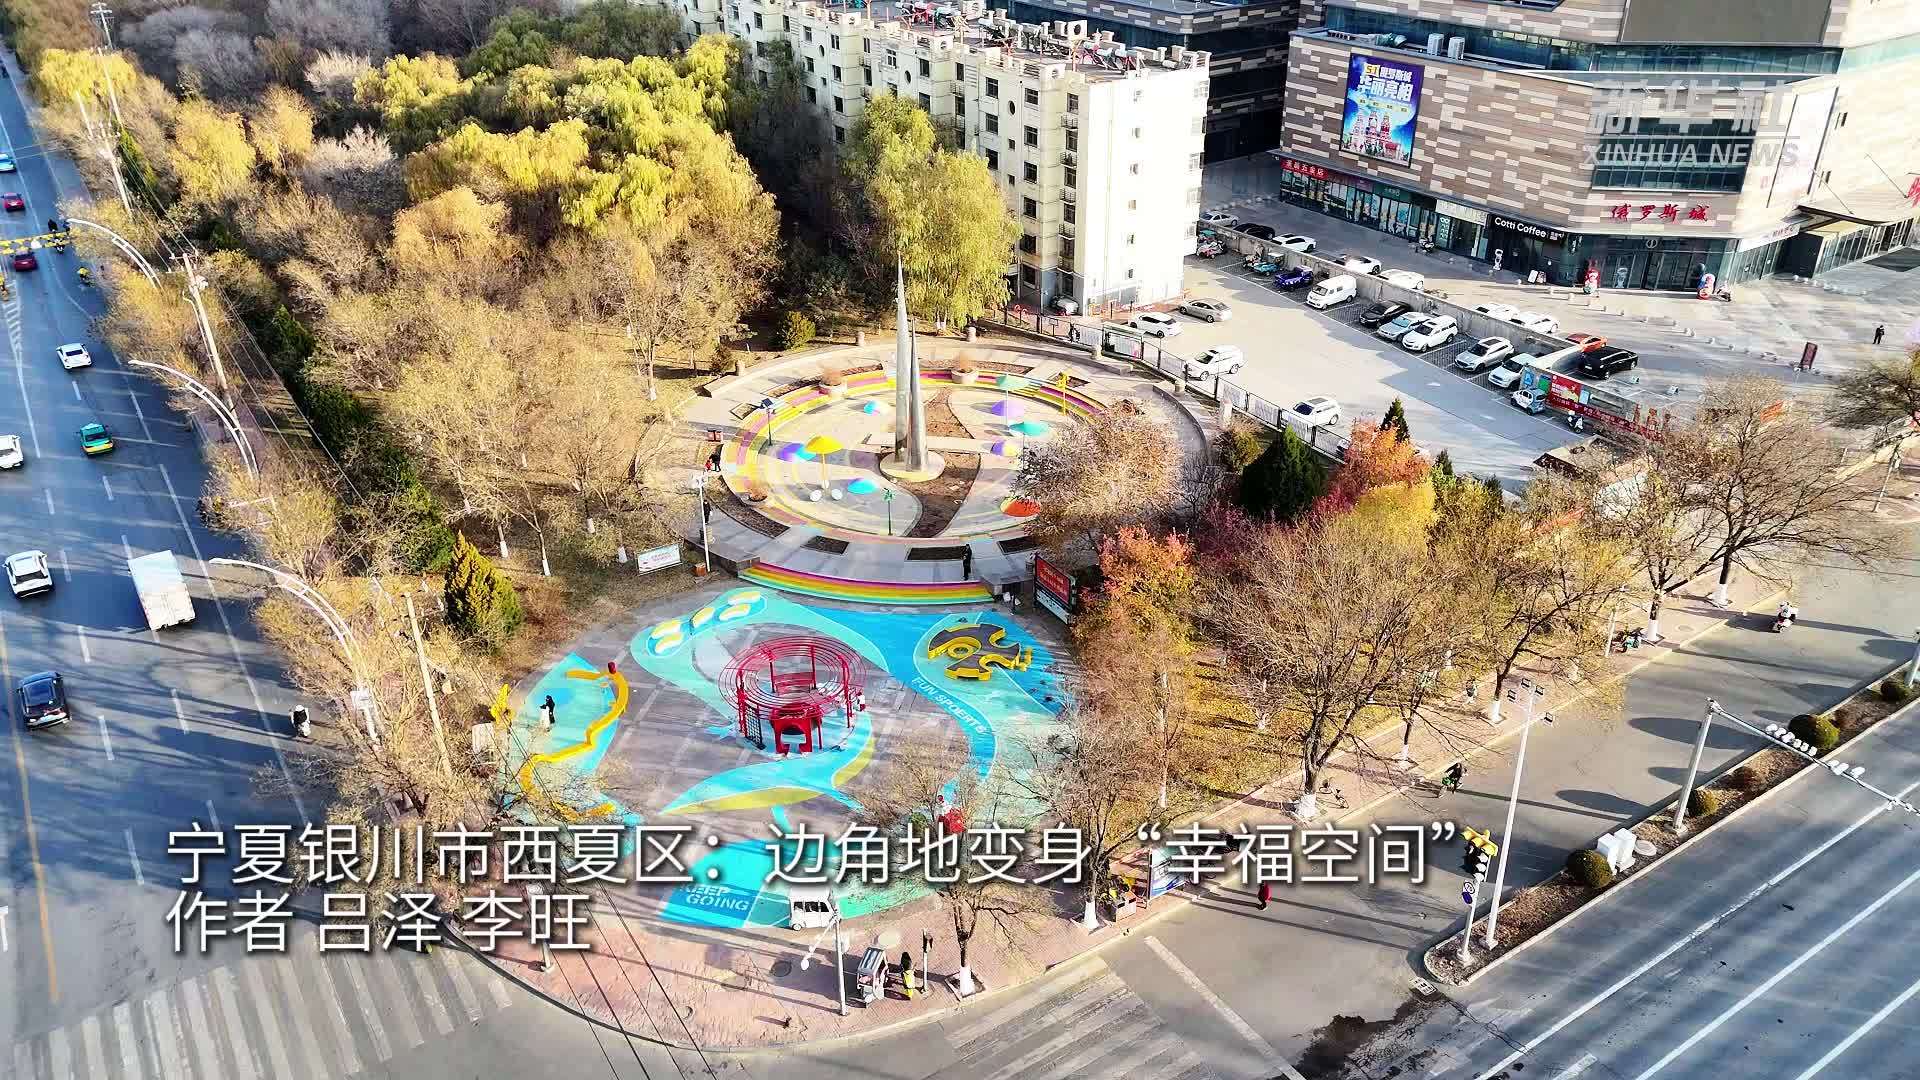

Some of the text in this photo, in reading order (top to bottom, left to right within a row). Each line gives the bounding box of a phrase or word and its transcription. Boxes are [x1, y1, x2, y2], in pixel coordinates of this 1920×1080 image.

[1357, 75, 1414, 102] 华丽亮相
[1611, 203, 1710, 222] 俄罗斯城
[1494, 216, 1516, 231] Cotti
[1517, 222, 1547, 238] Coffee
[911, 676, 938, 696] FUN
[686, 893, 749, 911] GOING
